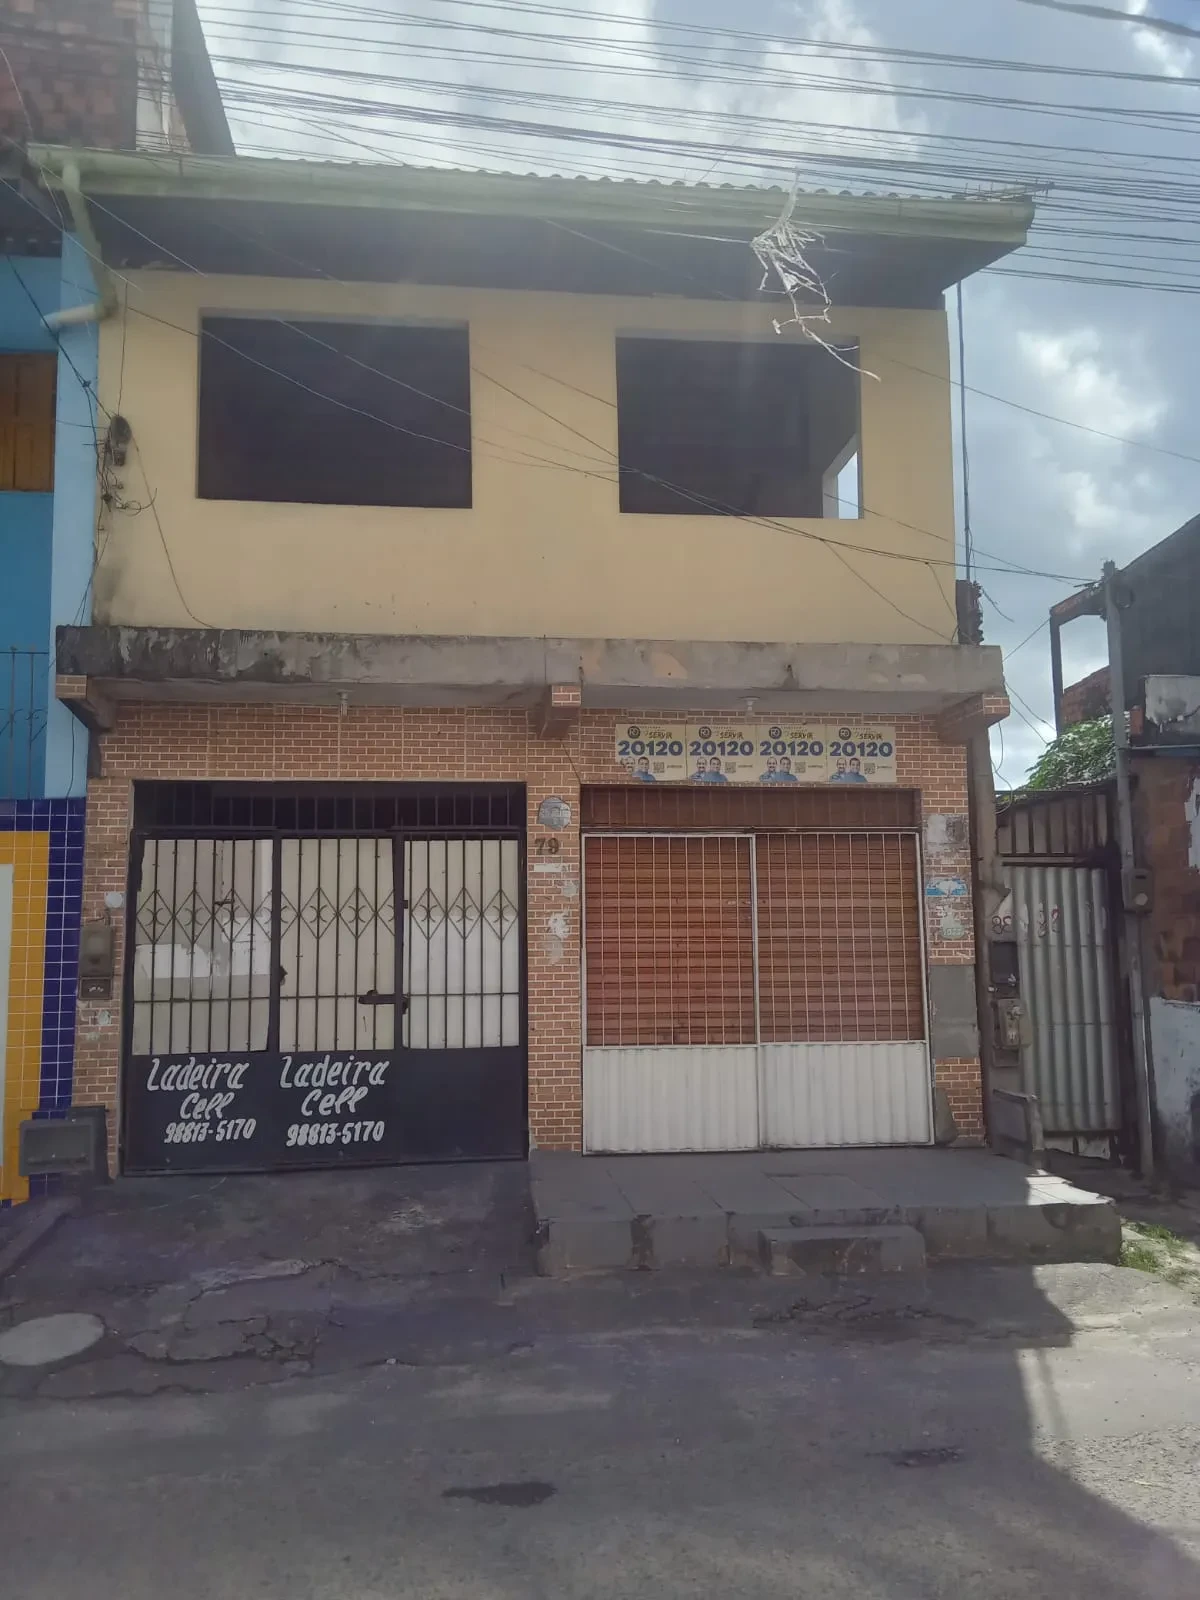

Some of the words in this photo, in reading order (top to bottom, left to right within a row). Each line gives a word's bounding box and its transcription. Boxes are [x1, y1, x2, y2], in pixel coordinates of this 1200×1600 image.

[618, 740, 683, 756] 20120
[689, 740, 754, 756] 20120
[760, 740, 824, 757] 20120
[829, 741, 893, 757] 20120
[534, 837, 560, 855] 79
[146, 1057, 250, 1091] Ladeira
[279, 1054, 390, 1088] Ladeira
[179, 1091, 235, 1120] Cell
[300, 1086, 369, 1116] Cell
[164, 1118, 257, 1144] 98813-5170
